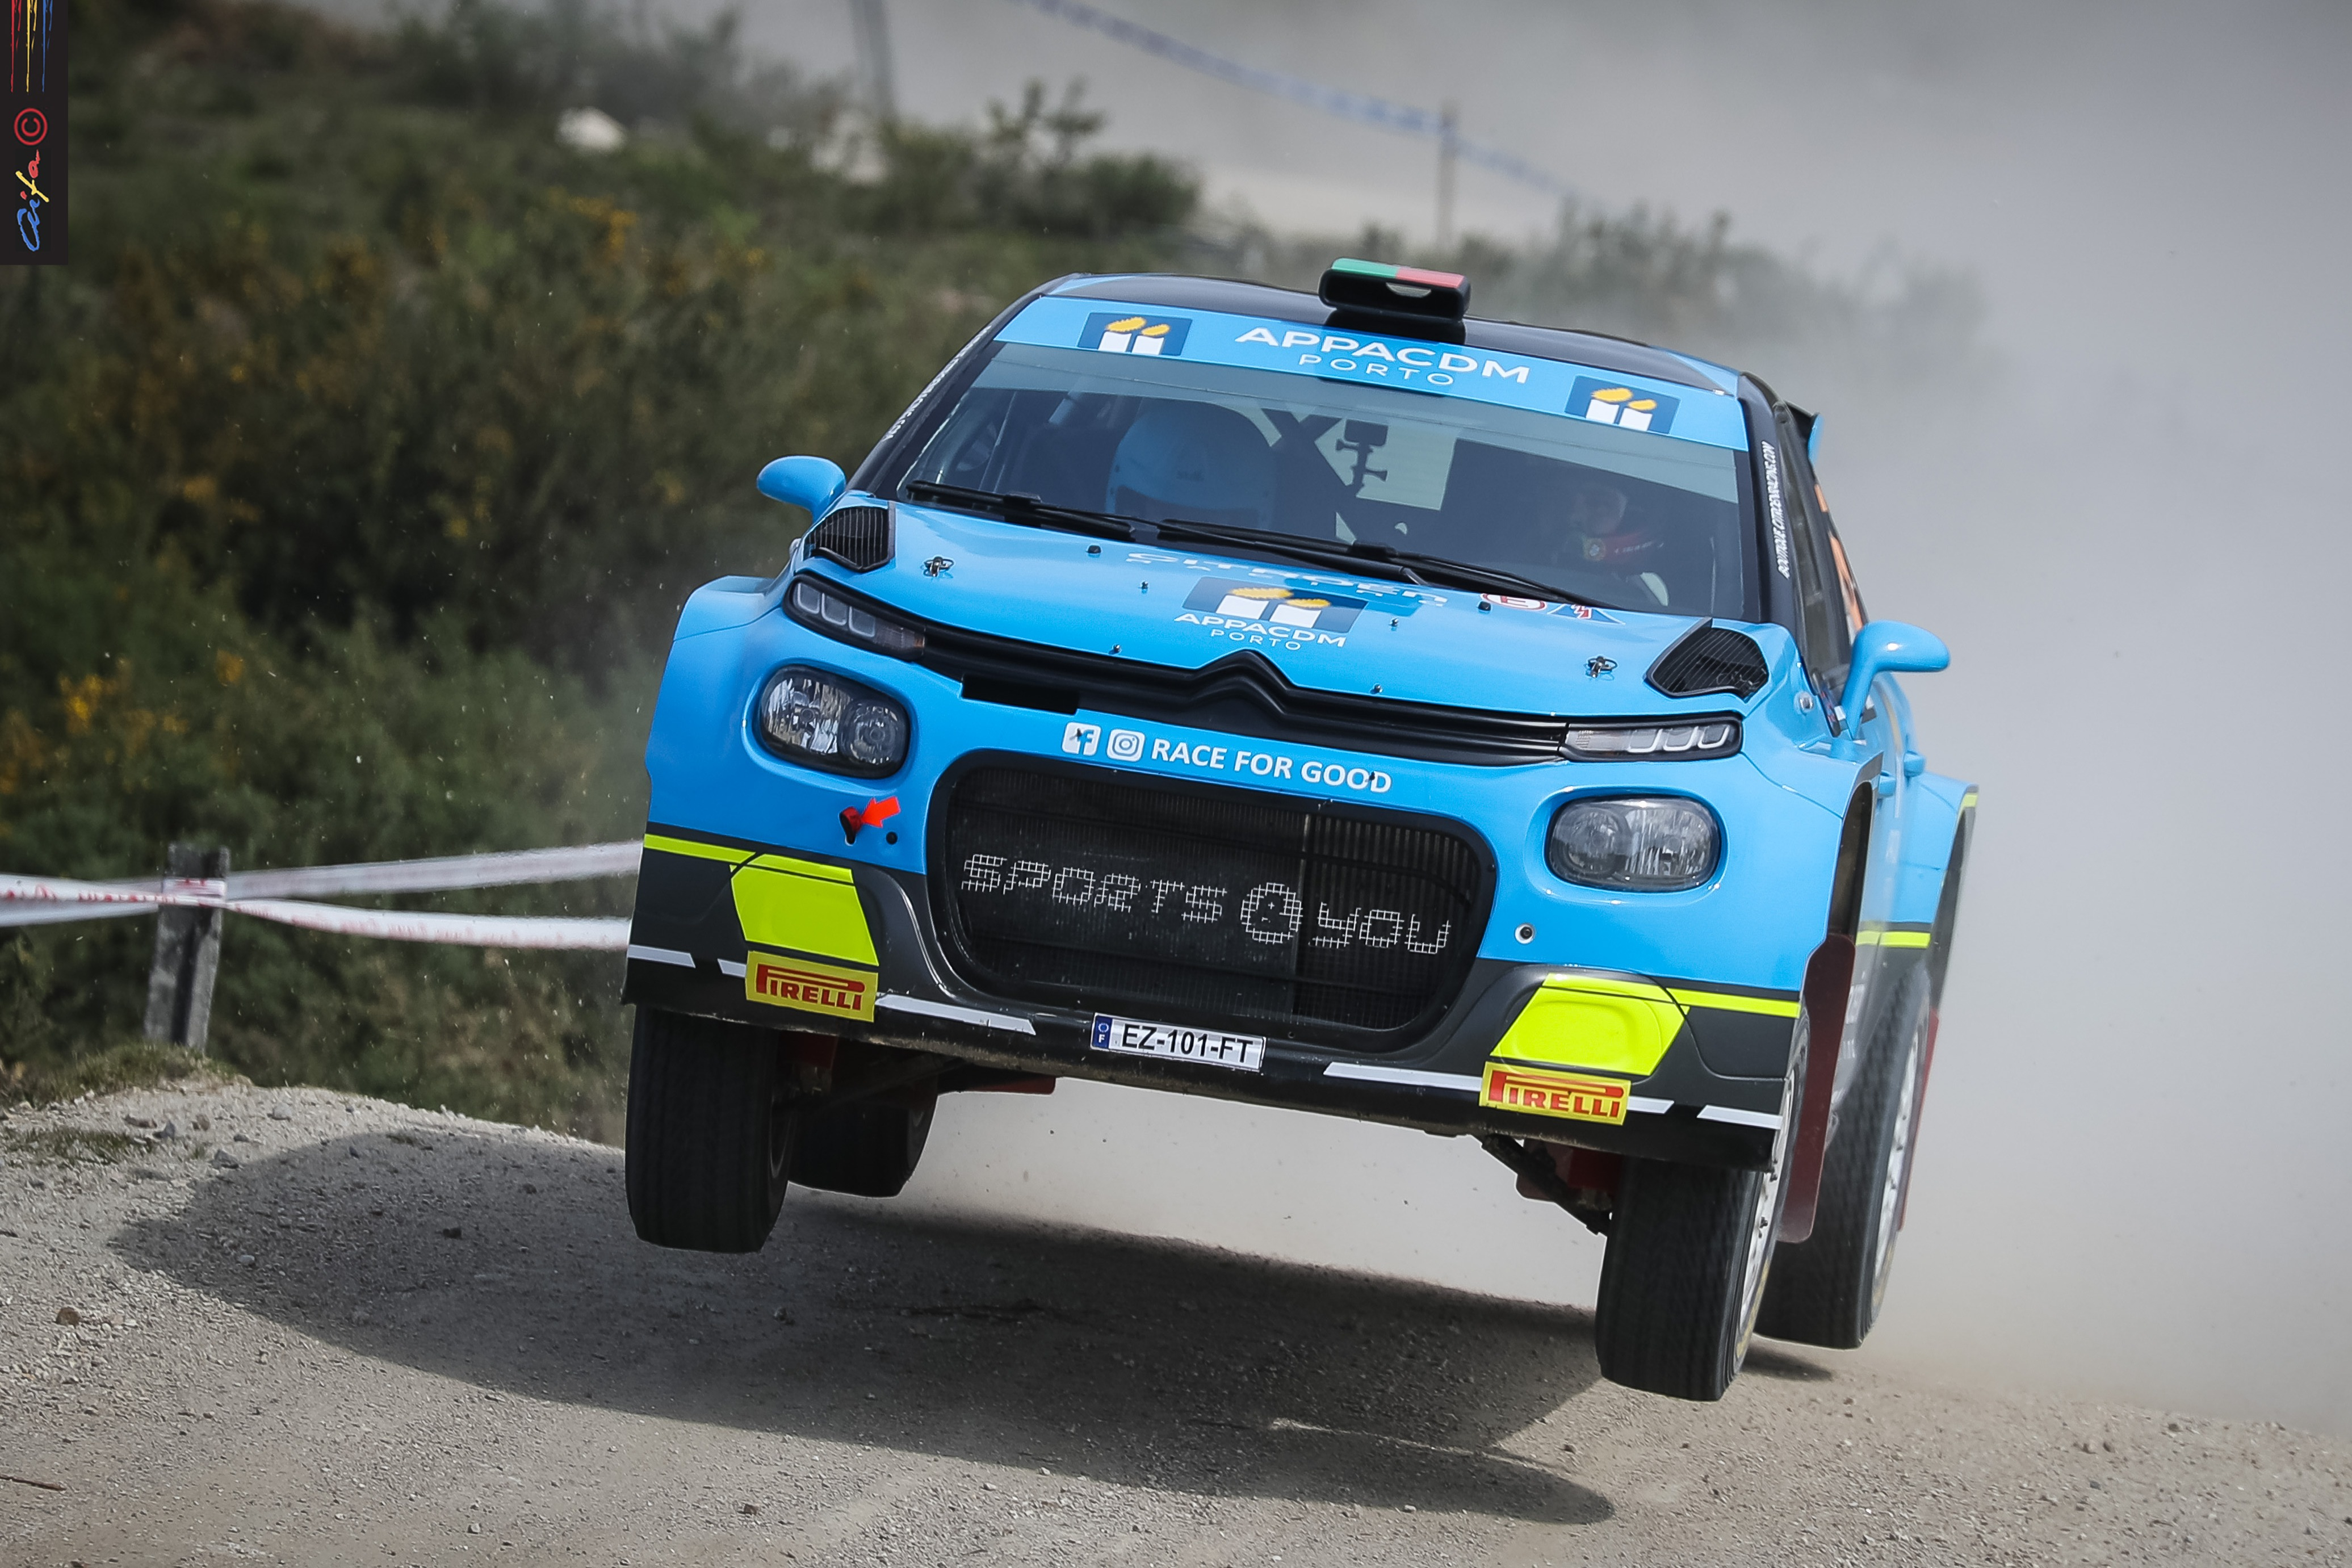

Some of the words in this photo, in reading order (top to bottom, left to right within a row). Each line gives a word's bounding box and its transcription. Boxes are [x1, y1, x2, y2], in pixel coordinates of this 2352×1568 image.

[1235, 326, 1529, 384] APPACDM
[1299, 354, 1454, 385] PORTO
[1173, 613, 1346, 647] APPACDM
[1210, 628, 1301, 651] PORTO
[1151, 738, 1227, 769] RACE
[1234, 751, 1292, 779] FOR
[1301, 761, 1391, 793] GOOD
[961, 854, 1227, 924] SPORTS
[756, 963, 865, 1011] PIRELLI
[1098, 1034, 1105, 1043] F
[1121, 1024, 1253, 1063] EZ-101-FT
[1489, 1070, 1624, 1118] PIRELLI
